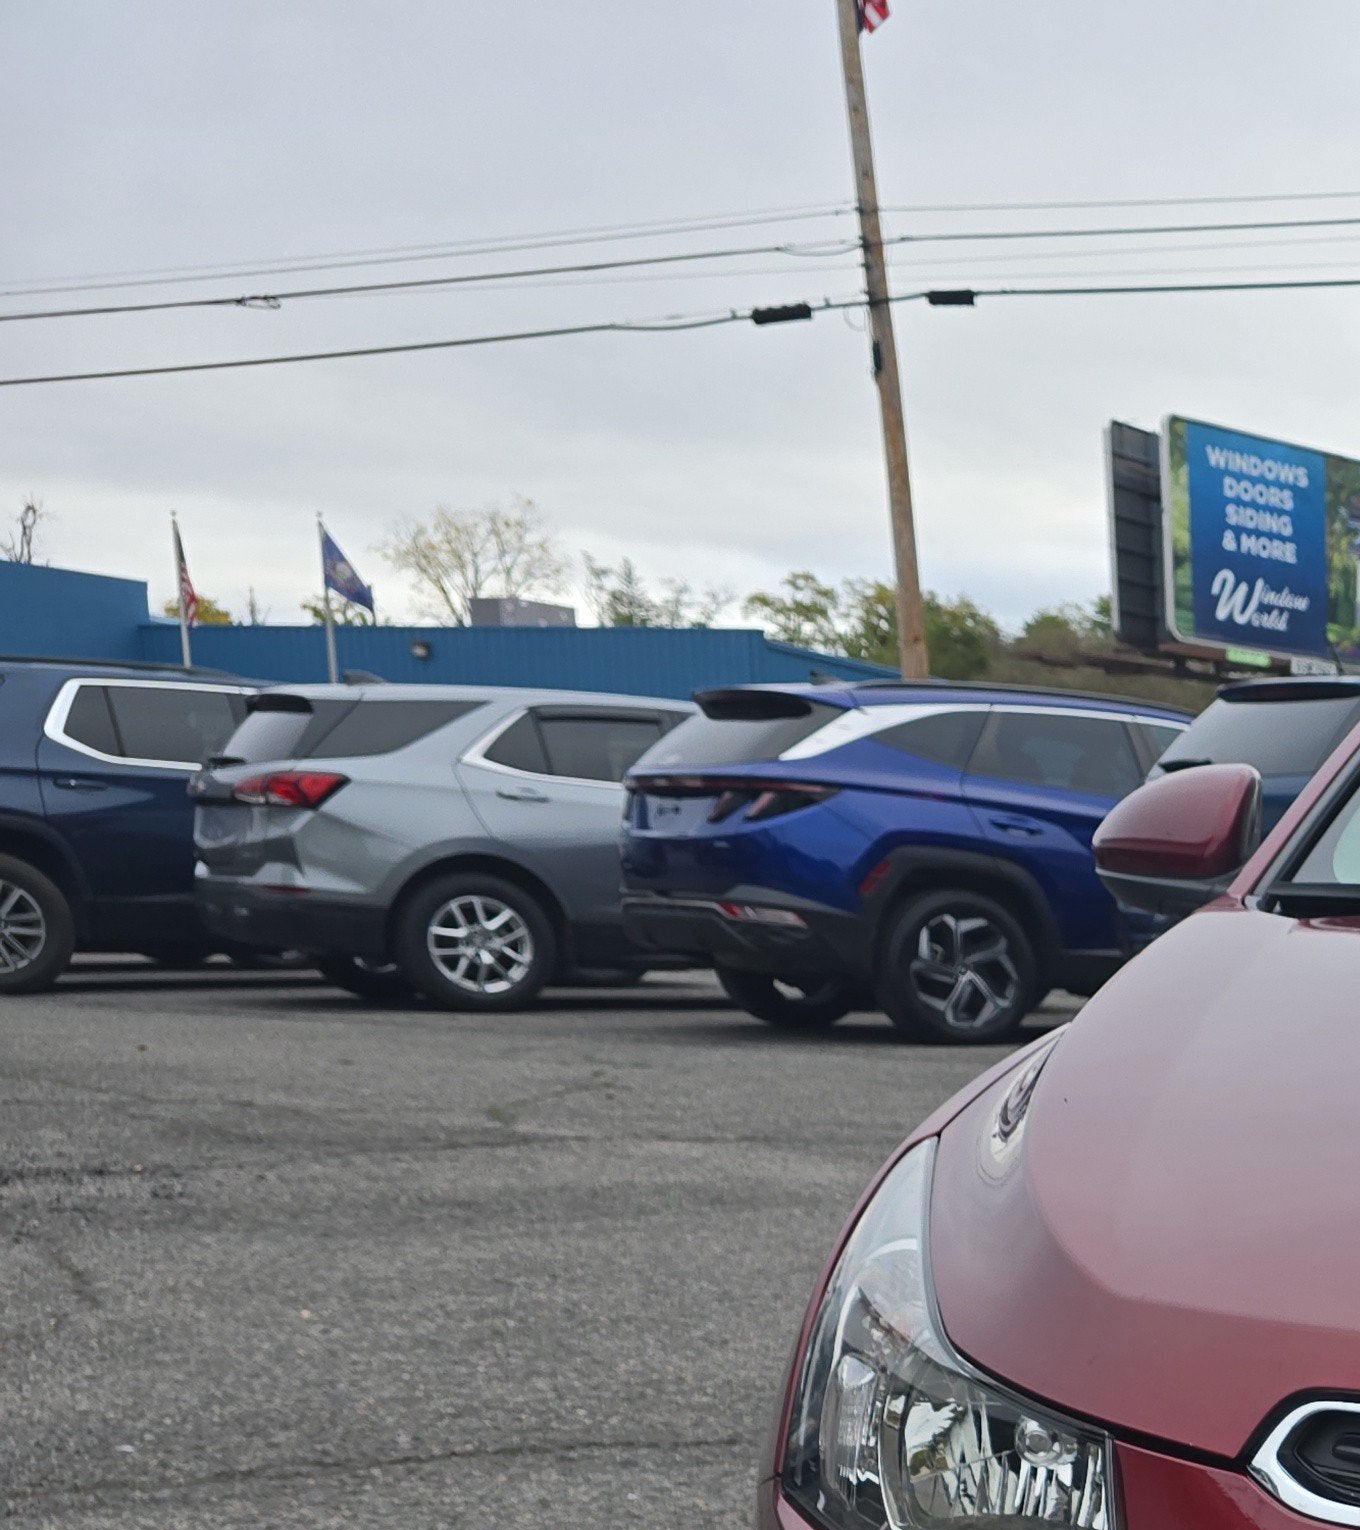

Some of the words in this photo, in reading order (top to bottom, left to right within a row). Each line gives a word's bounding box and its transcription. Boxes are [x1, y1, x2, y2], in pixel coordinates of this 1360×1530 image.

[1205, 444, 1309, 489] WINDOWS
[1223, 475, 1294, 512] DOORS
[1225, 503, 1293, 537] SIDING
[1222, 529, 1237, 552] &
[1240, 532, 1298, 564] MORE
